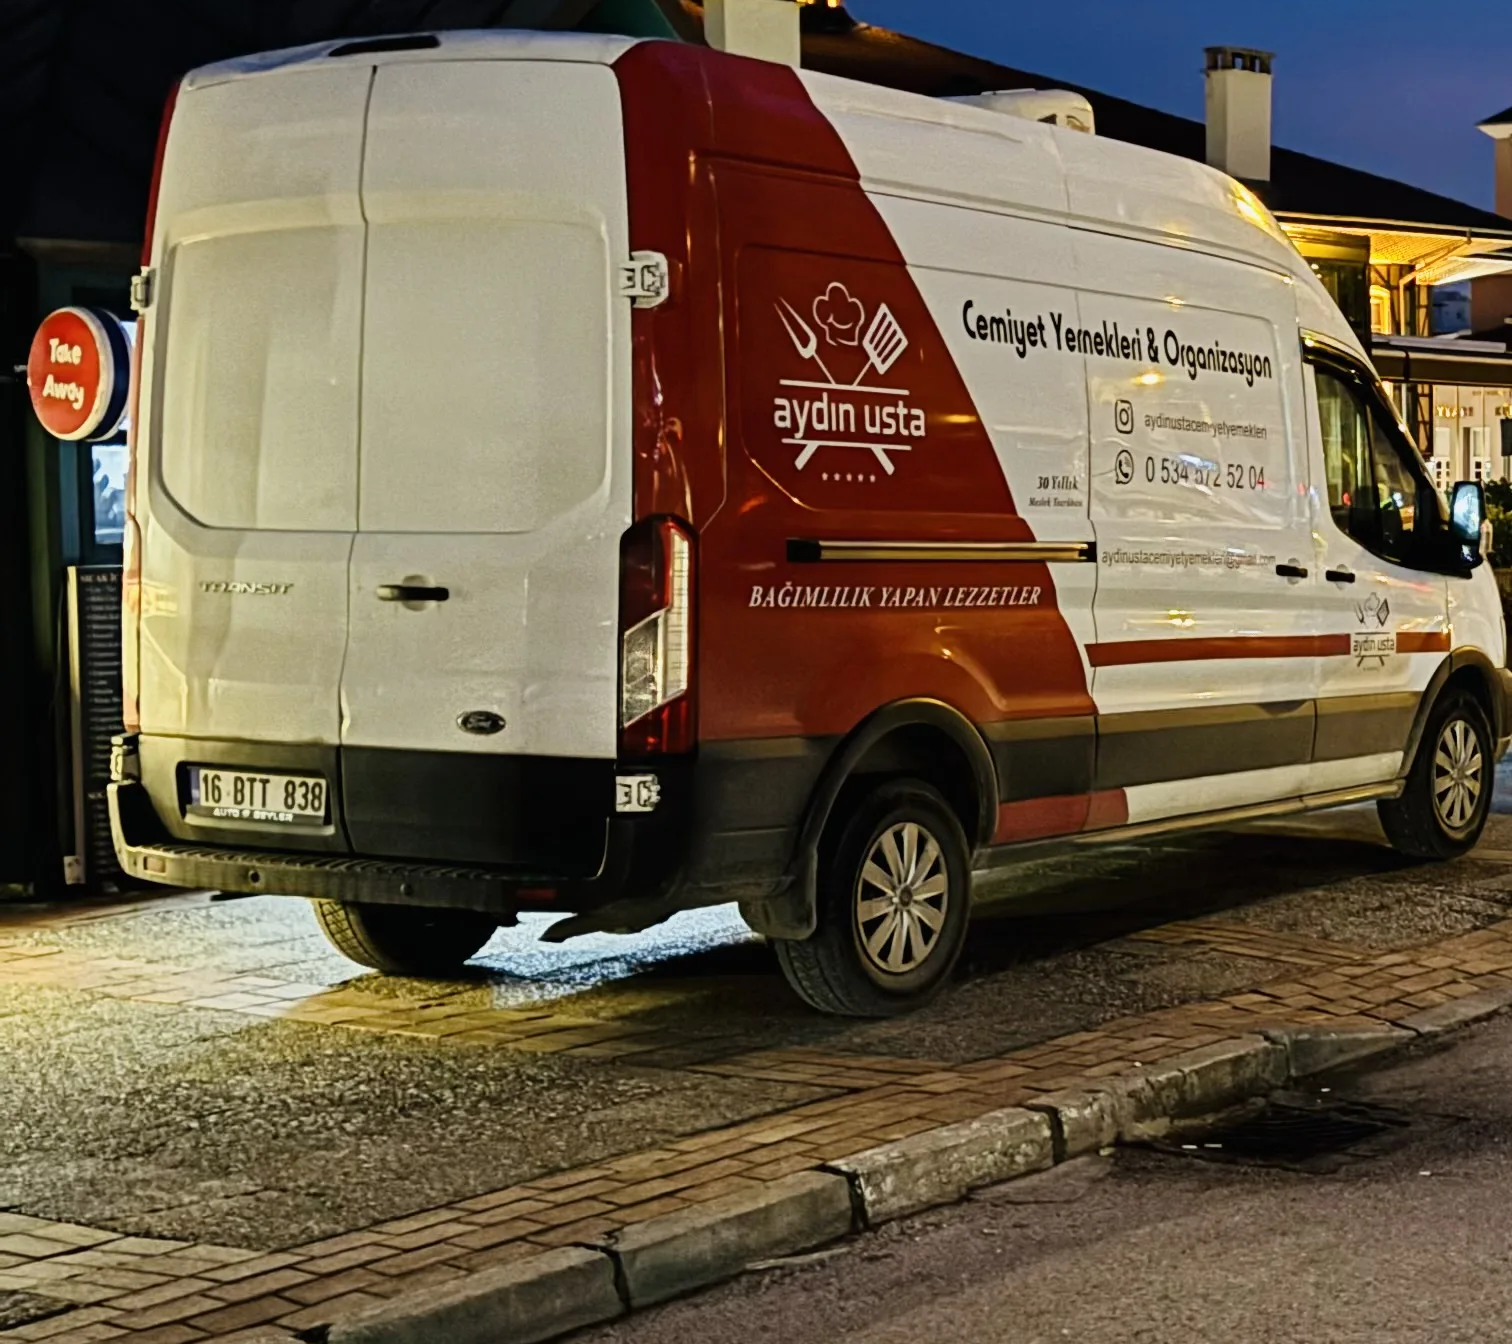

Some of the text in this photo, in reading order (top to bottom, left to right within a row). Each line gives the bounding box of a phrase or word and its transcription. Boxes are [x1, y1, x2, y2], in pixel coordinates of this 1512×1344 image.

[49, 337, 82, 366] Take
[962, 299, 1273, 388] Cemiyet Yemekleri & Organizasyon
[42, 373, 85, 411] Away
[773, 391, 926, 440] aydın usta
[1036, 475, 1079, 490] 30 Yıllık
[1145, 456, 1155, 483] 0
[1161, 457, 1189, 485] 534
[1227, 464, 1244, 490] 52
[1248, 465, 1265, 492] 04
[199, 581, 295, 595] TRANSIT
[748, 581, 1042, 607] BAĞIMLILIK YAPAN LEZZETLER
[202, 773, 323, 813] 16 BTT 838
